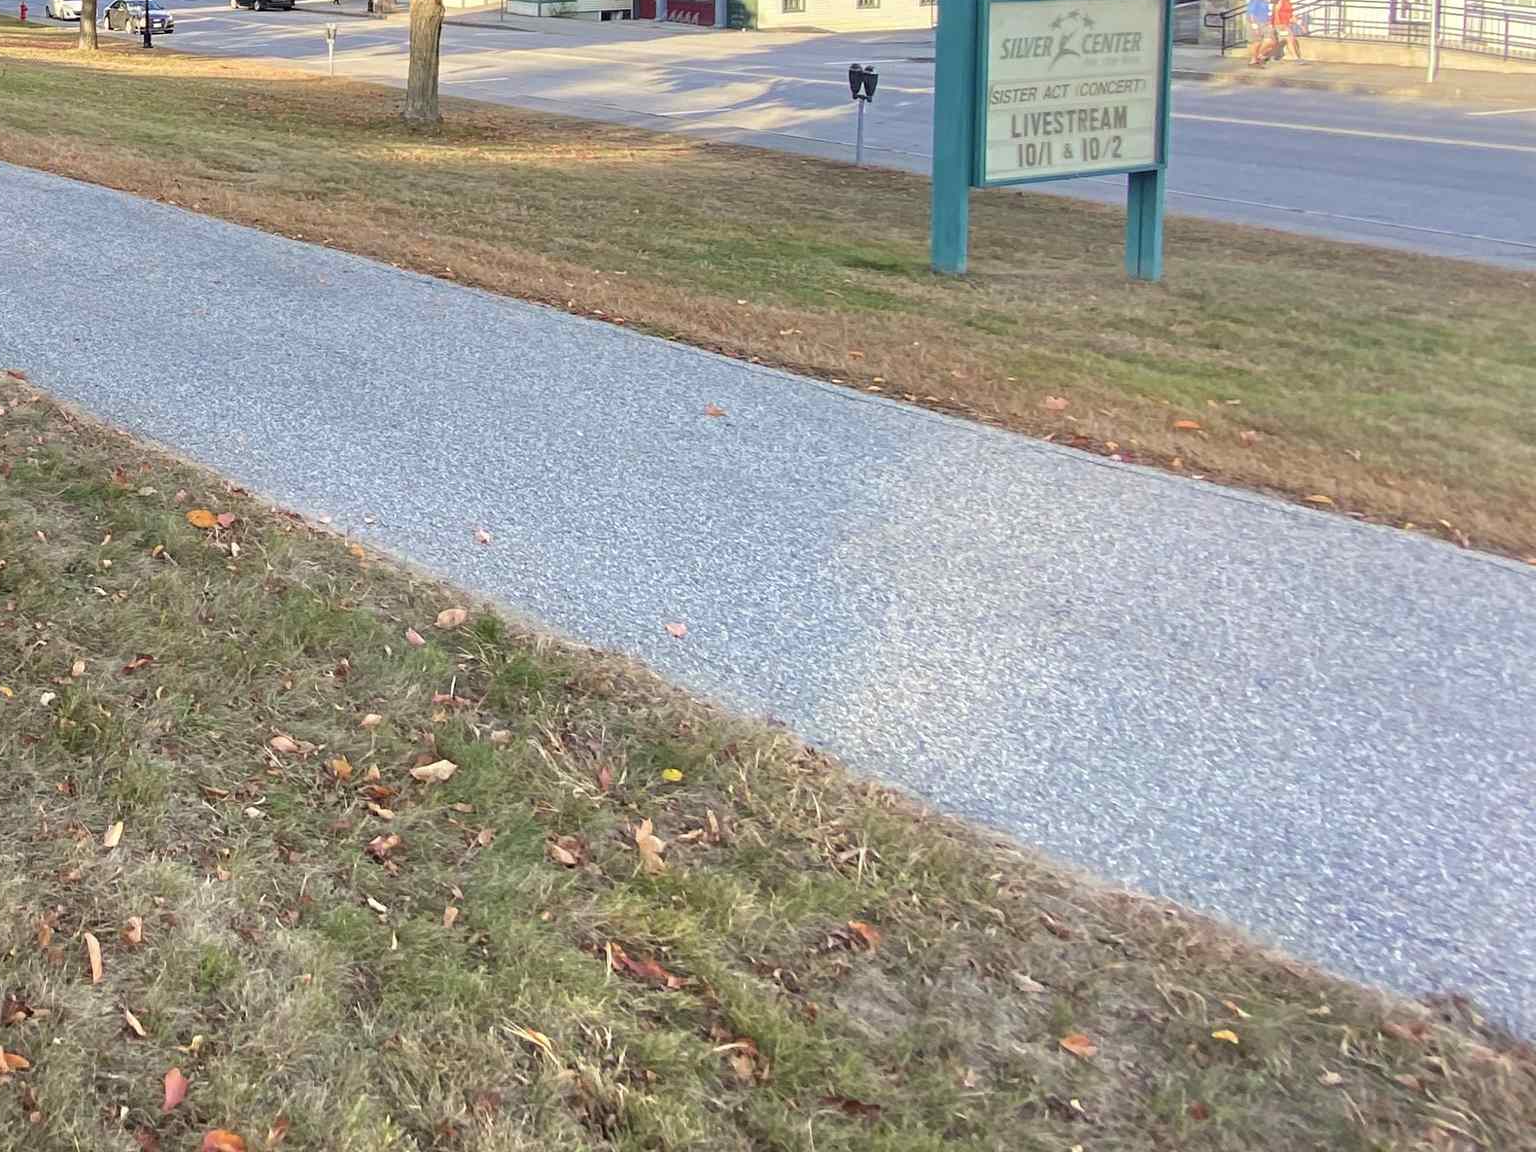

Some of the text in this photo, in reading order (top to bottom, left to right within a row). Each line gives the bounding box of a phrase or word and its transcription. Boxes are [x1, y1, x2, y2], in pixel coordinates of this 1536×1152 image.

[1000, 32, 1143, 60] SILVER CENTER
[990, 86, 1038, 105] SISTER
[1043, 84, 1070, 100] ACT
[1011, 105, 1128, 138] LIVESTREAM
[1017, 135, 1123, 167] 10/1 & 10/2
